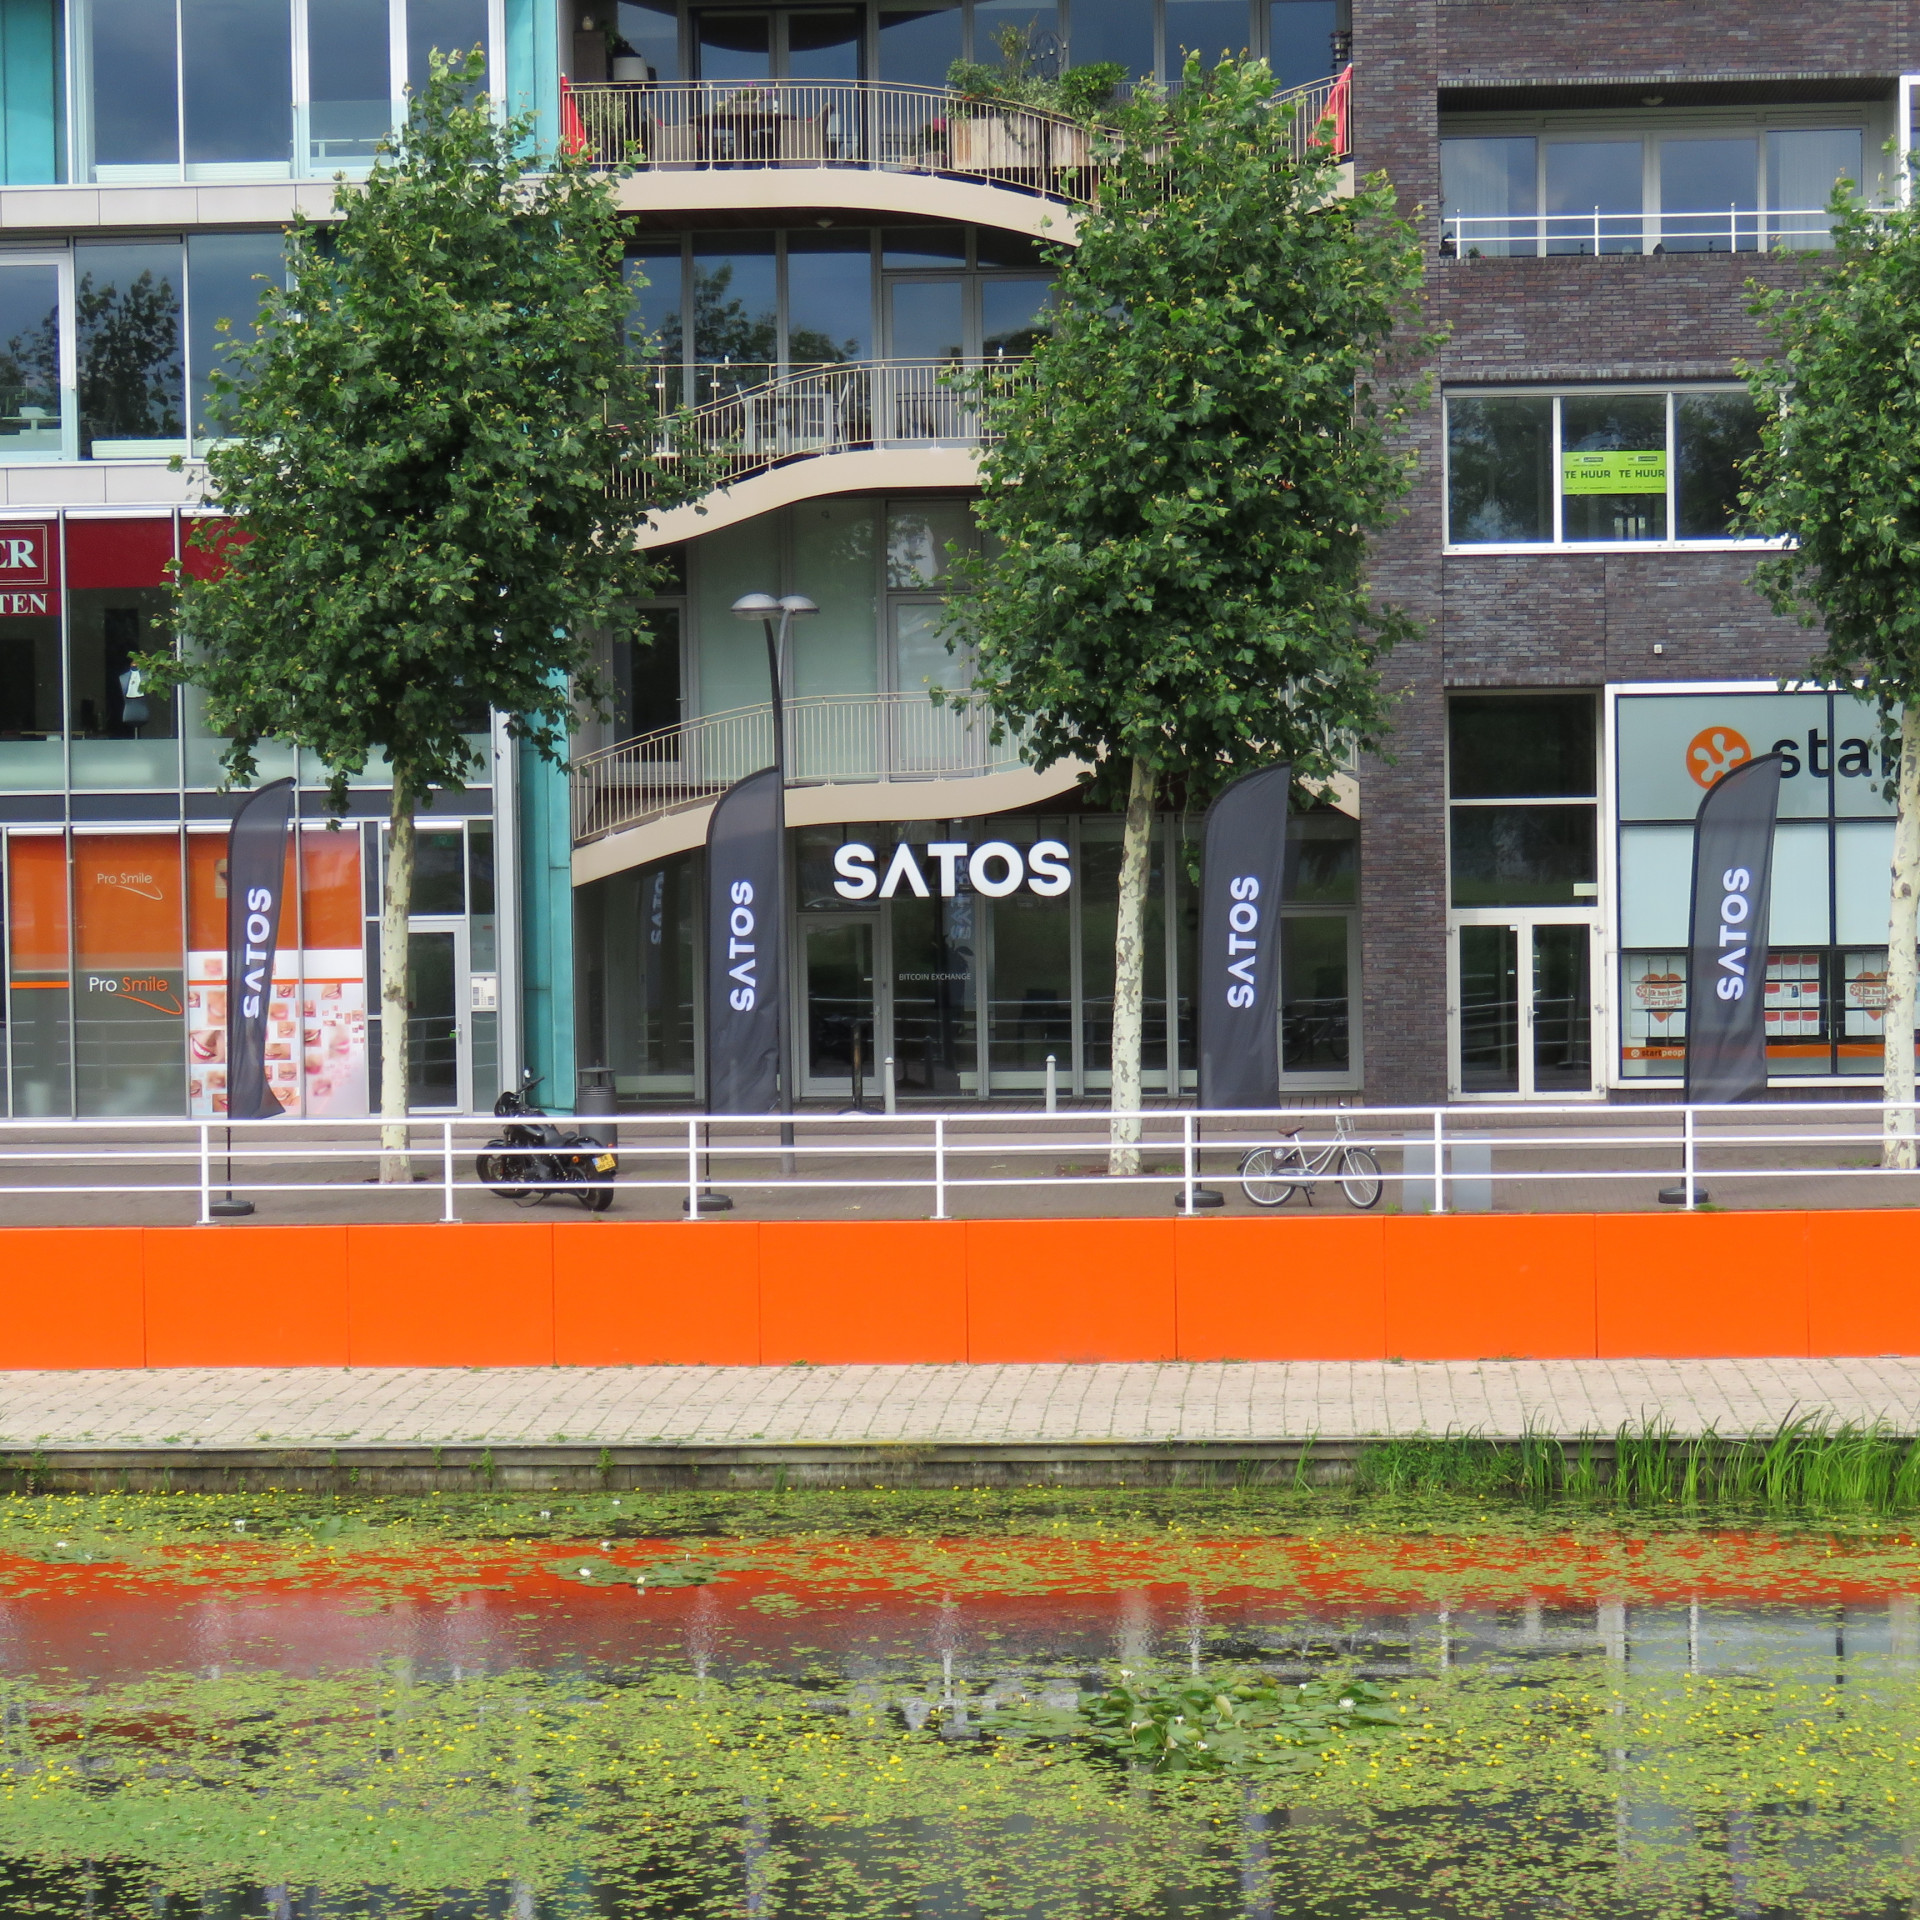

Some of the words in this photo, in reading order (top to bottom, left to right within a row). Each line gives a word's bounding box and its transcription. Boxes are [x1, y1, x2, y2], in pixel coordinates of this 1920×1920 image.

[1564, 470, 1577, 479] TE
[1580, 470, 1611, 478] HUUR
[1619, 469, 1631, 478] TE
[1635, 469, 1665, 478] HUUR
[97, 873, 117, 885] Pro
[120, 872, 153, 884] Smile
[833, 840, 1072, 900] SATOS
[243, 888, 272, 1019] SATOS
[728, 881, 756, 1012] SATOS
[1226, 876, 1260, 1009] SATOS
[1716, 868, 1750, 1001] SATOS
[89, 976, 118, 992] Pro
[121, 975, 169, 992] Smile
[898, 973, 930, 981] BITCOIN
[931, 972, 972, 981] EXCHANGE
